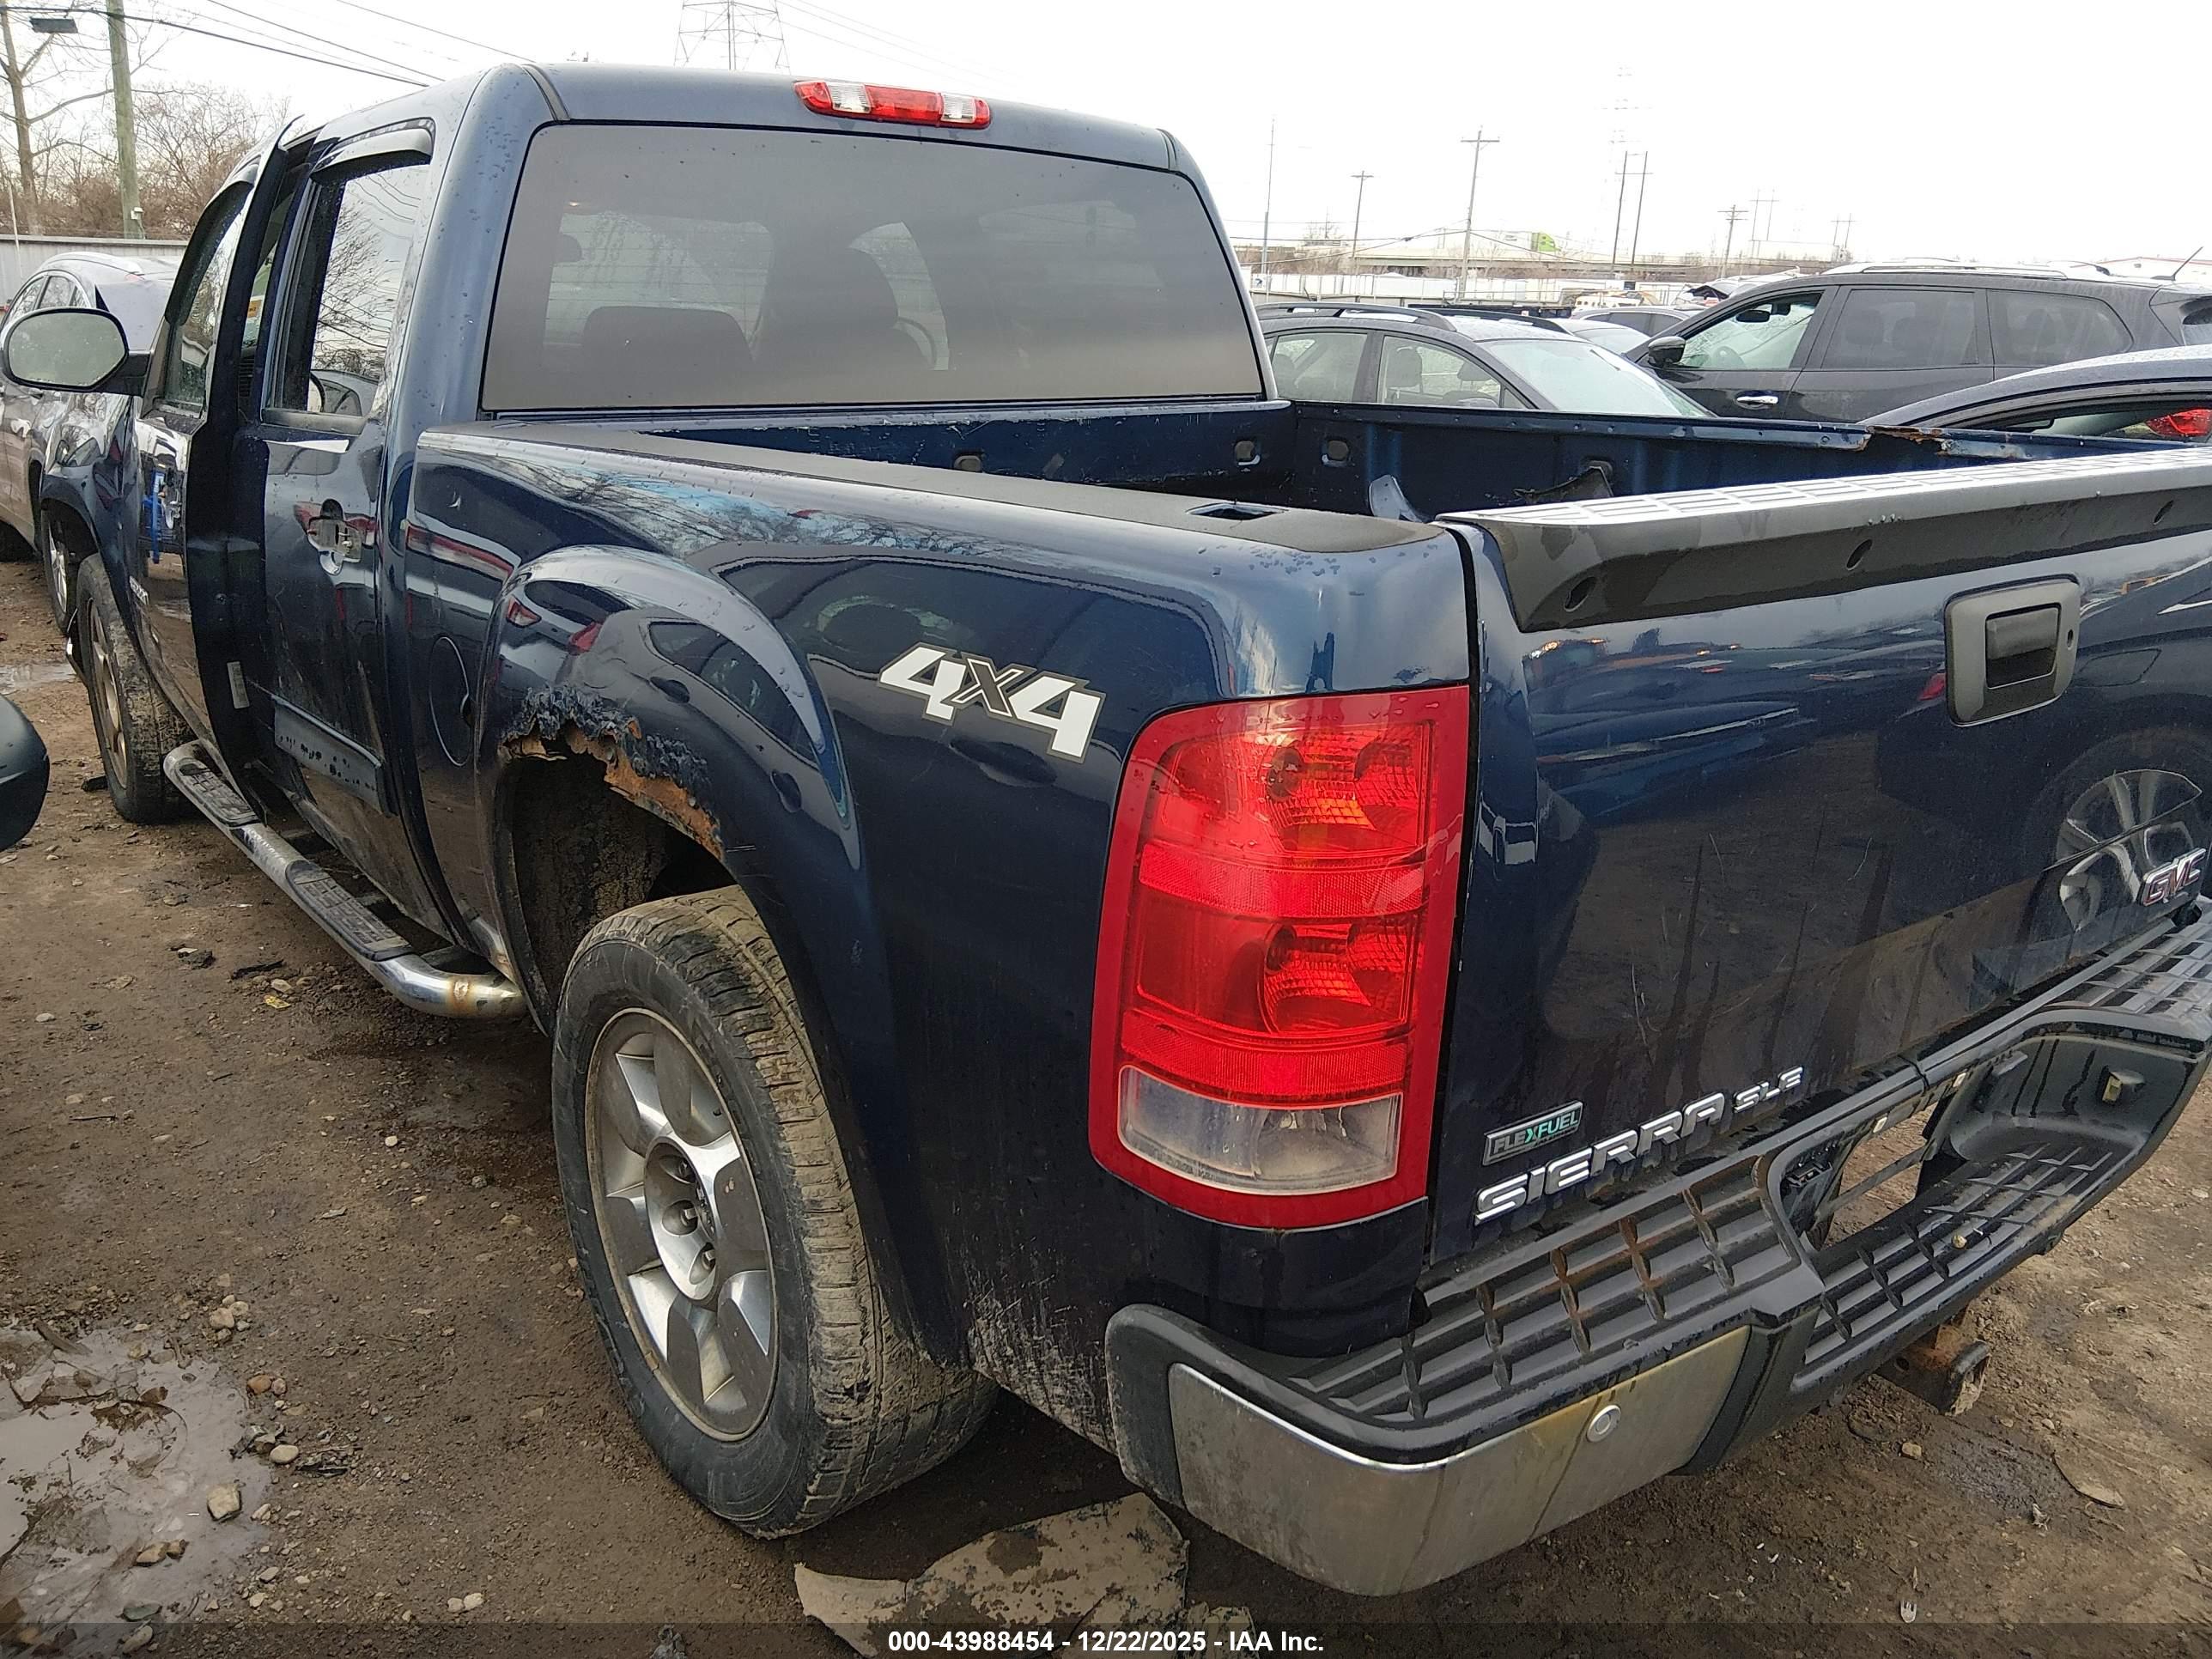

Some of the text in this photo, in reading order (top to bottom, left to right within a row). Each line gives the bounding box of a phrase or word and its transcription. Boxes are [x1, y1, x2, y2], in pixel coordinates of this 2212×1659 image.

[2142, 848, 2206, 906] GMC
[1474, 1066, 1803, 1225] SIERRA SLE
